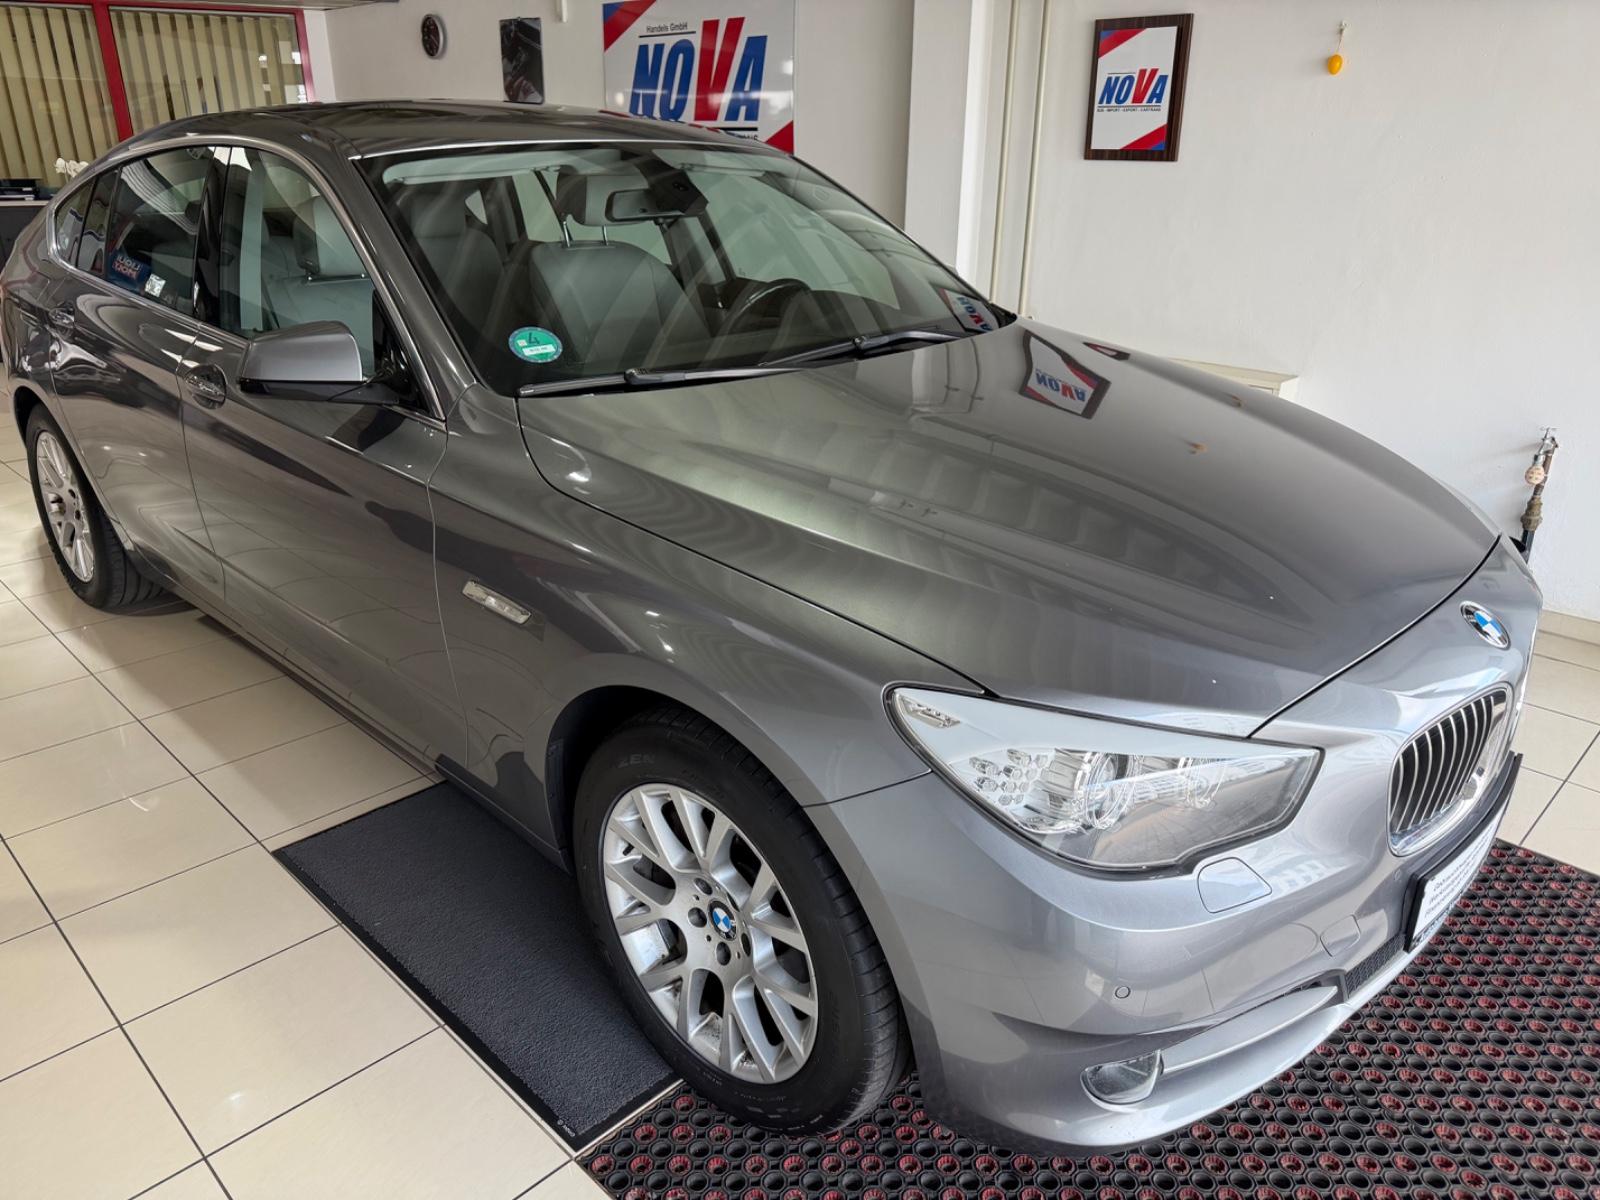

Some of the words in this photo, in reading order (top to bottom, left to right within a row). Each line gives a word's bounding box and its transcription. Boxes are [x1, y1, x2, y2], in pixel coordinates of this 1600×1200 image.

[646, 24, 669, 34] Handels
[670, 22, 688, 32] GmbH
[629, 17, 768, 121] NOVA
[1098, 68, 1169, 104] NOVA
[528, 332, 540, 345] 4
